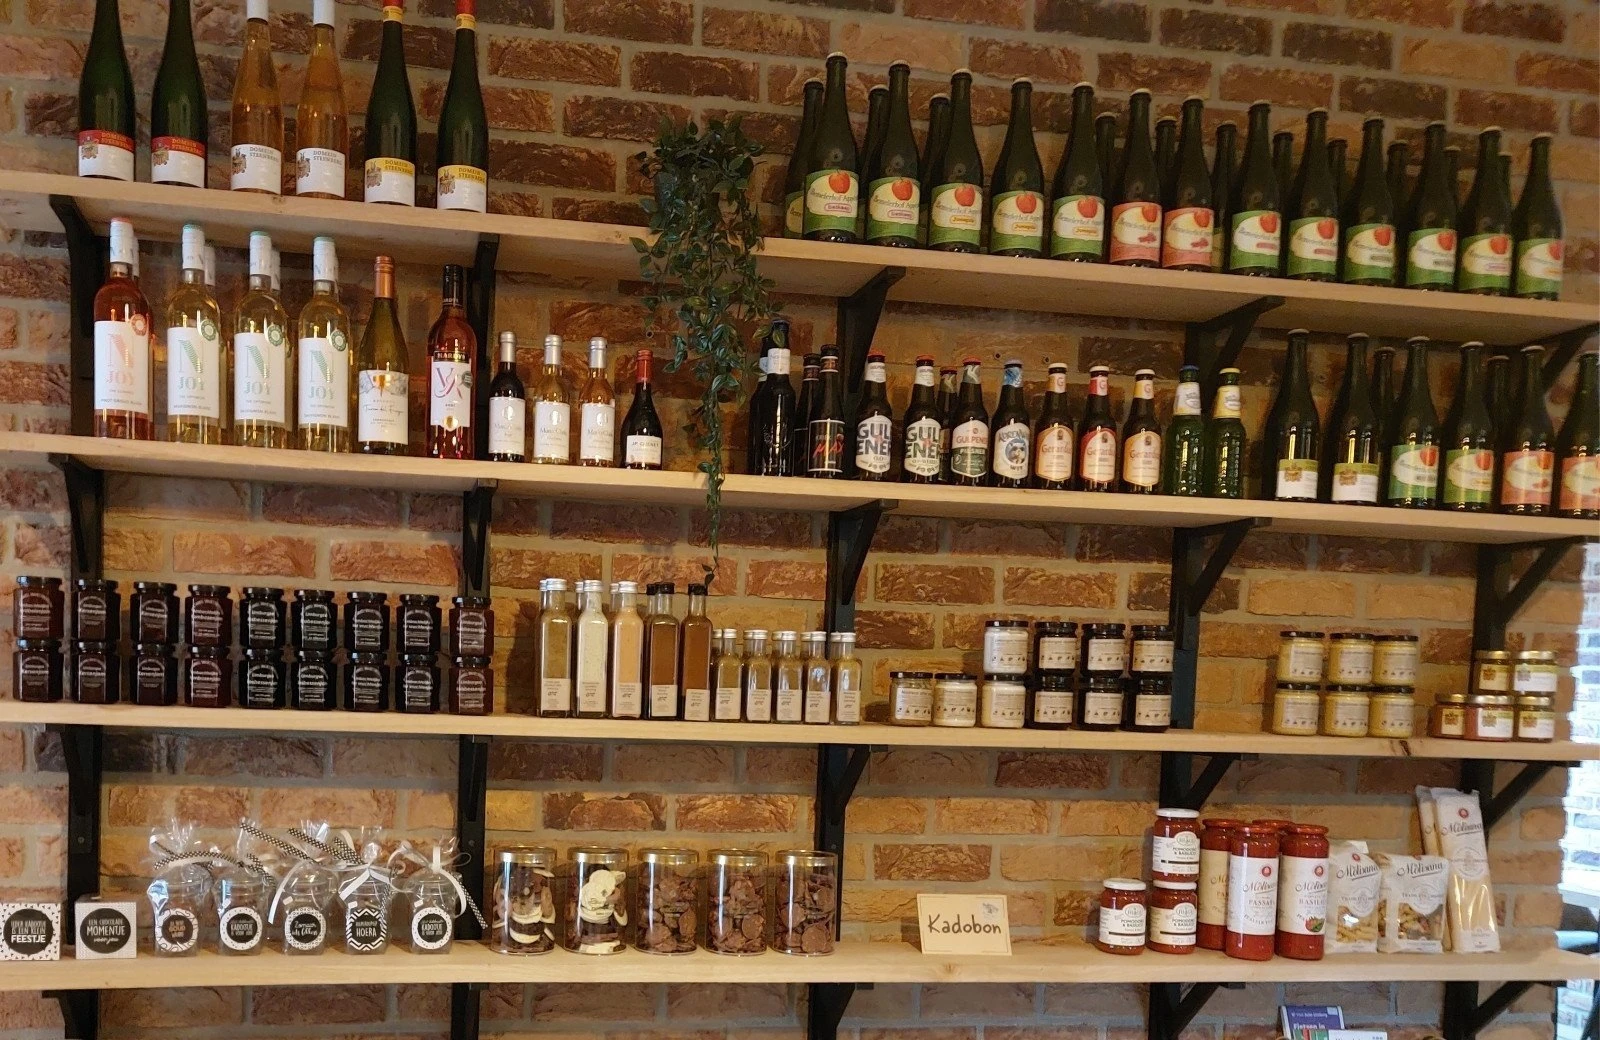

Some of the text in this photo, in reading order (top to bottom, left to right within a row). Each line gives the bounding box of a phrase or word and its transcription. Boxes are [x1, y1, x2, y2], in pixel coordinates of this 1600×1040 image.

[928, 914, 1001, 934] Kadobon
[86, 925, 125, 936] MOMENTJE
[356, 928, 377, 937] HOERA
[11, 935, 46, 943] FEESTJE
